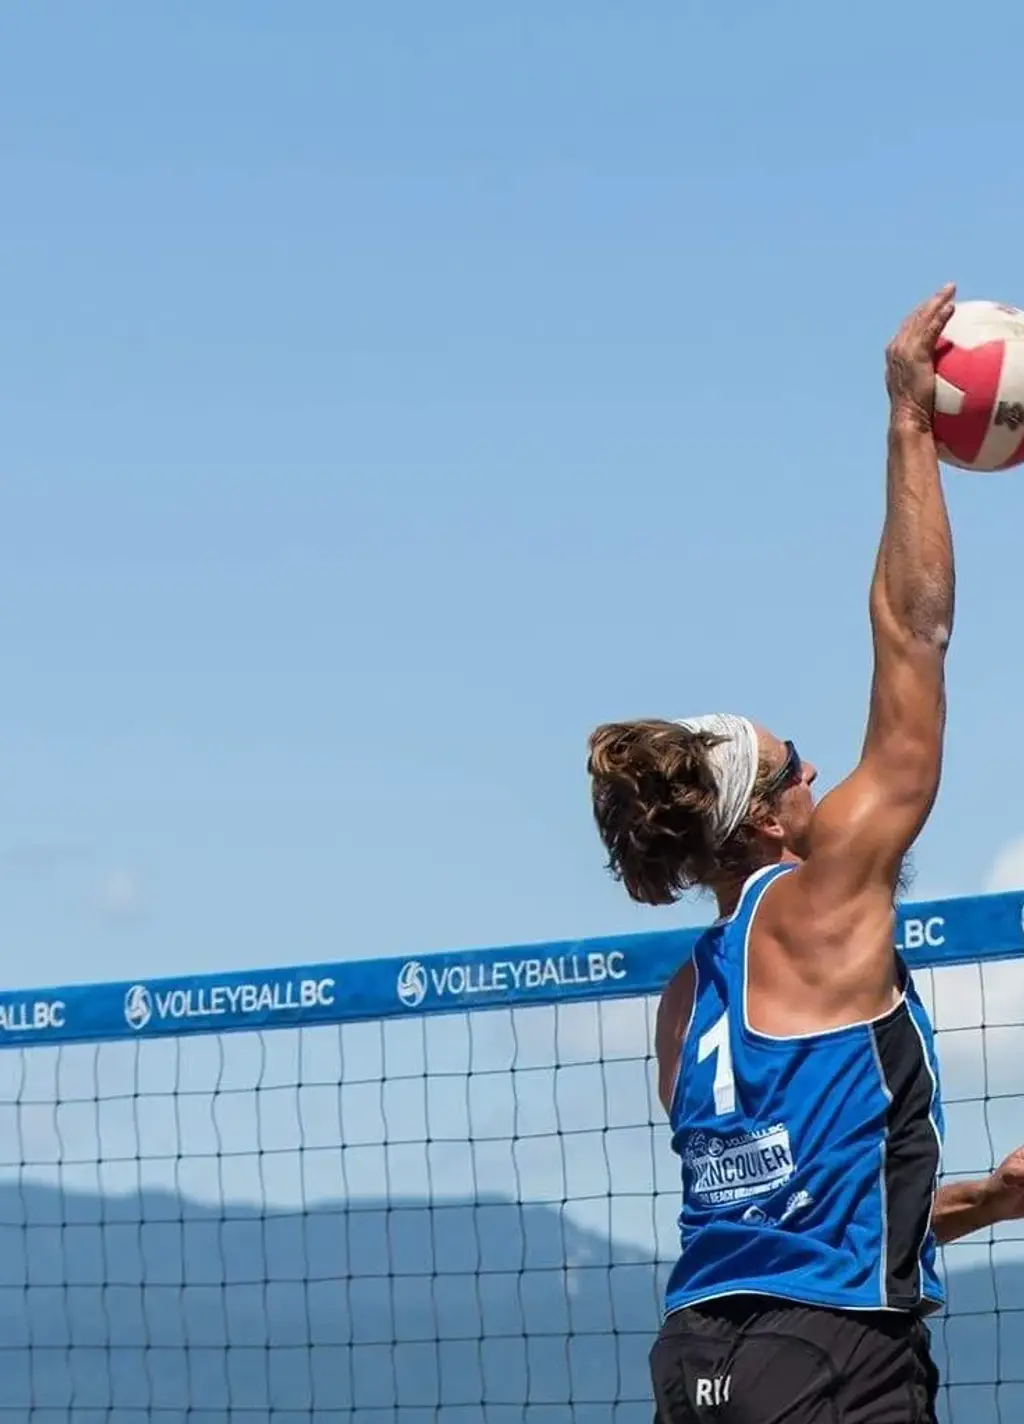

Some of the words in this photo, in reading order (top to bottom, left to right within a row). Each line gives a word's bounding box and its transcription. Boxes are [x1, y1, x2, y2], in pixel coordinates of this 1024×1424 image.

[895, 916, 946, 949] BC
[431, 951, 627, 996] VOLLEYBALLBC
[155, 978, 335, 1020] VOLLEYBALLBC
